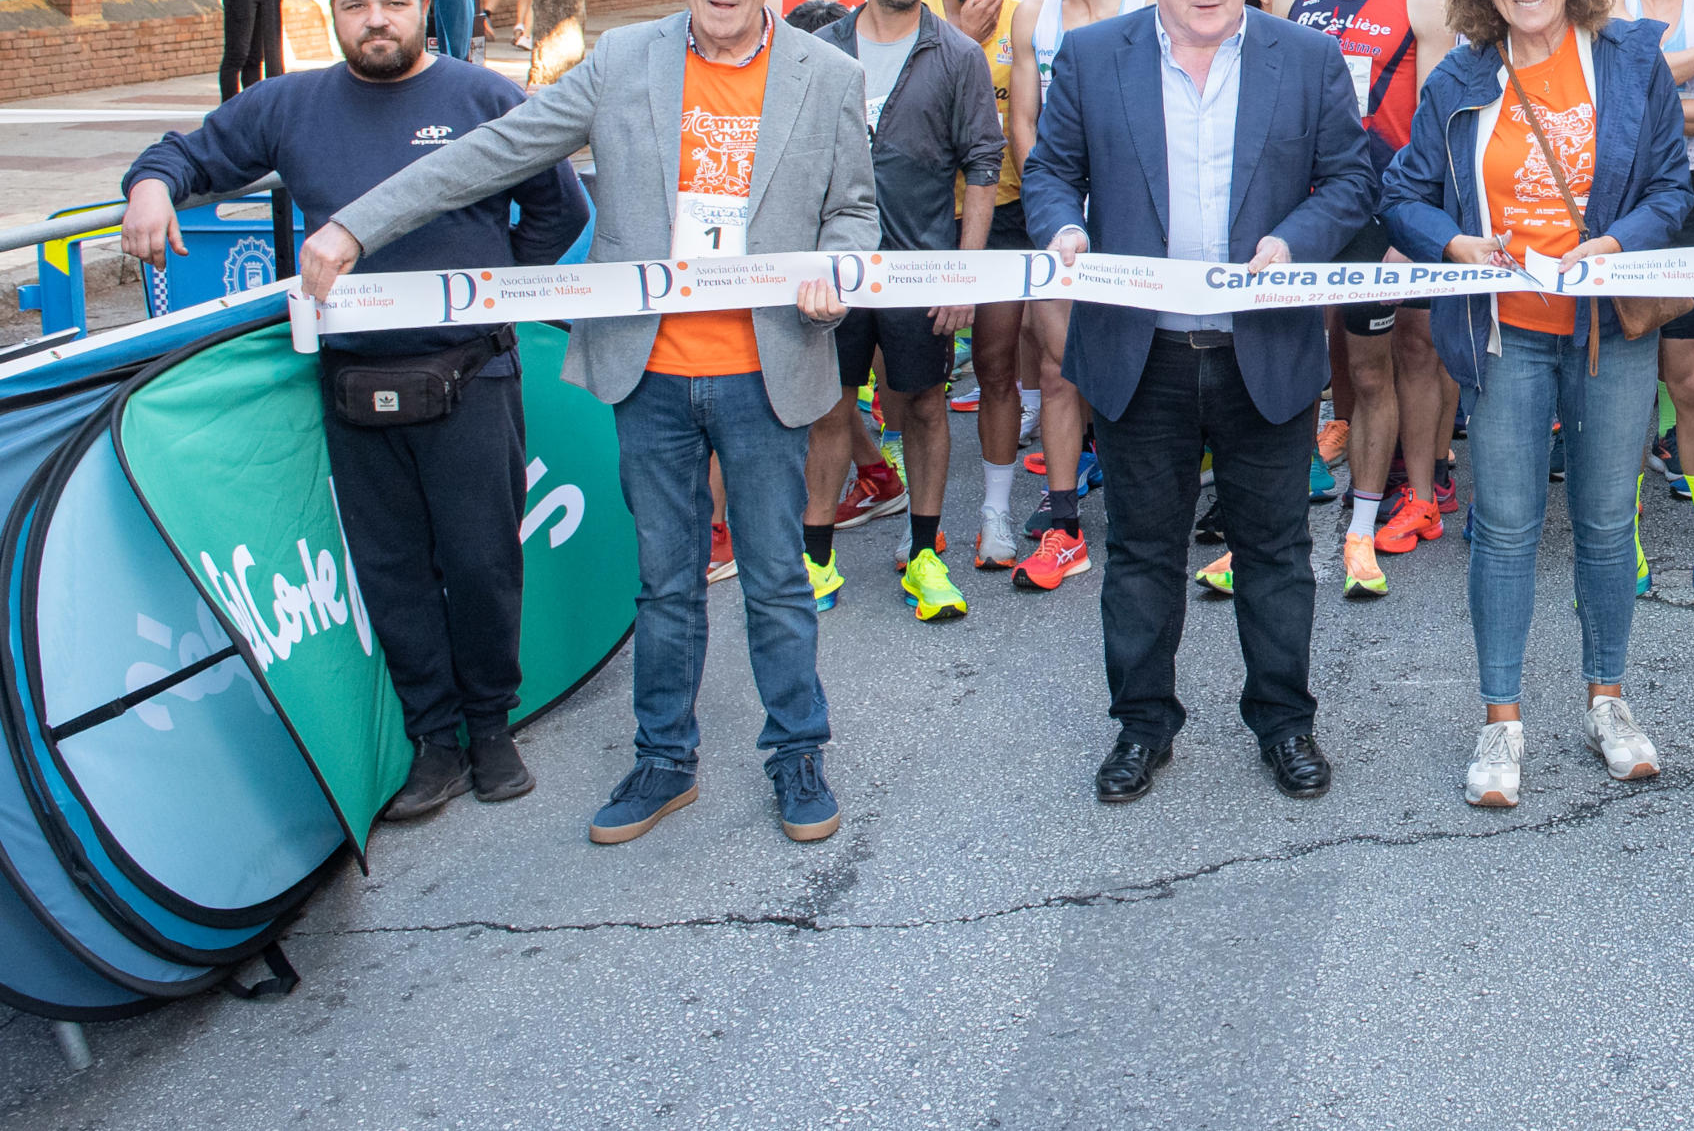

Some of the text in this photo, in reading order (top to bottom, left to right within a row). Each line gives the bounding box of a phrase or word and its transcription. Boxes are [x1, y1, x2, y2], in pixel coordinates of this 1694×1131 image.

[1344, 14, 1392, 36] Liège
[704, 226, 722, 250] 1
[696, 262, 775, 276] Asociación de la
[888, 260, 967, 271] Asociación de la
[1078, 262, 1154, 277] Asociación de la
[1611, 258, 1686, 270] Asociación de la
[500, 273, 580, 287] Asociación de la
[696, 273, 786, 287] Prensa de Málaga
[888, 272, 977, 284] Prensa de Málaga
[1078, 272, 1163, 290] Prensa de Málaga
[1205, 266, 1513, 290] Carrera de la Prensa
[1611, 271, 1644, 281] Prensa
[1647, 271, 1658, 280] de
[359, 284, 372, 294] de
[374, 283, 383, 293] la
[501, 284, 592, 299] Prensa de Málaga
[340, 298, 353, 308] de
[357, 296, 395, 308] Málaga
[1254, 287, 1456, 305] Málaga, 27 de Octubre de 2024
